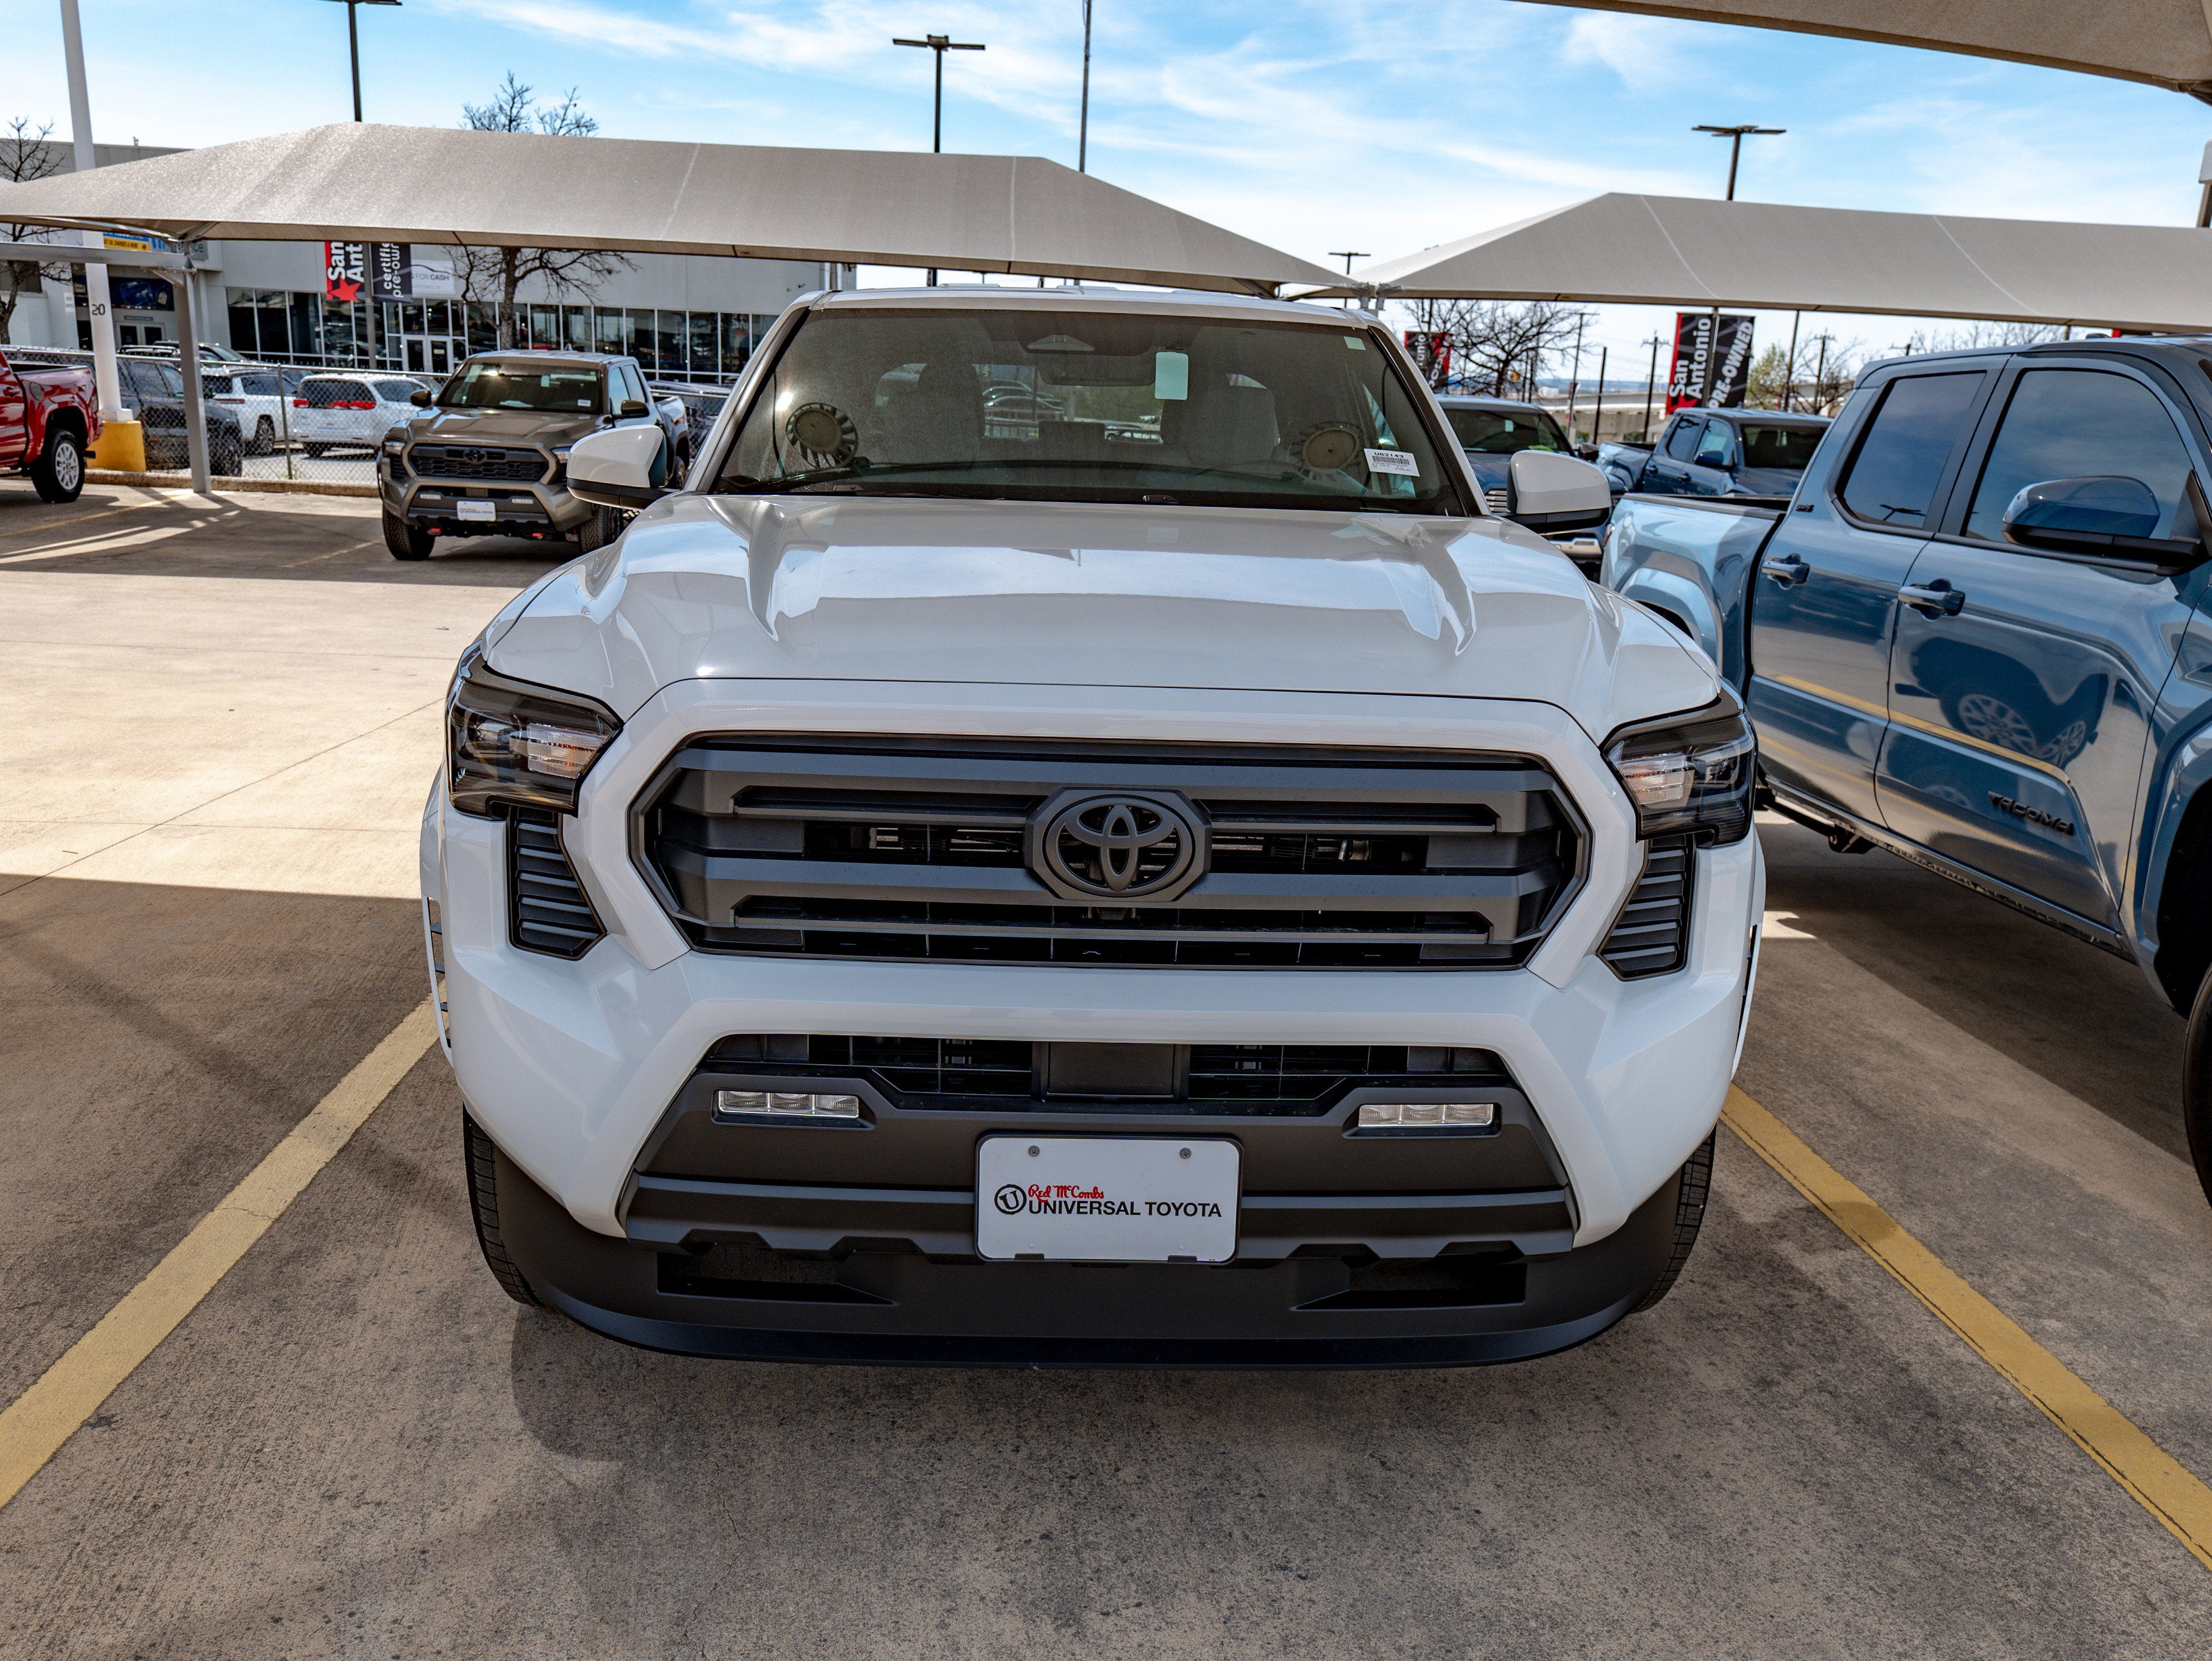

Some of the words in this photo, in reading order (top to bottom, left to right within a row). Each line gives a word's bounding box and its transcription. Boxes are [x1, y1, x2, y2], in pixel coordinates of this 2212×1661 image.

[327, 241, 346, 281] San
[345, 244, 365, 283] Ant
[92, 304, 106, 316] 20
[1685, 318, 1711, 399] Antonio
[1707, 321, 1754, 408] PRE-OWNED
[1669, 360, 1690, 398] San
[1988, 790, 2074, 835] TACOMA
[1028, 1184, 1051, 1203] Red
[1053, 1185, 1104, 1199] McCombs
[1029, 1200, 1141, 1216] UNIVERSAL
[1145, 1201, 1222, 1217] TOYOTA
